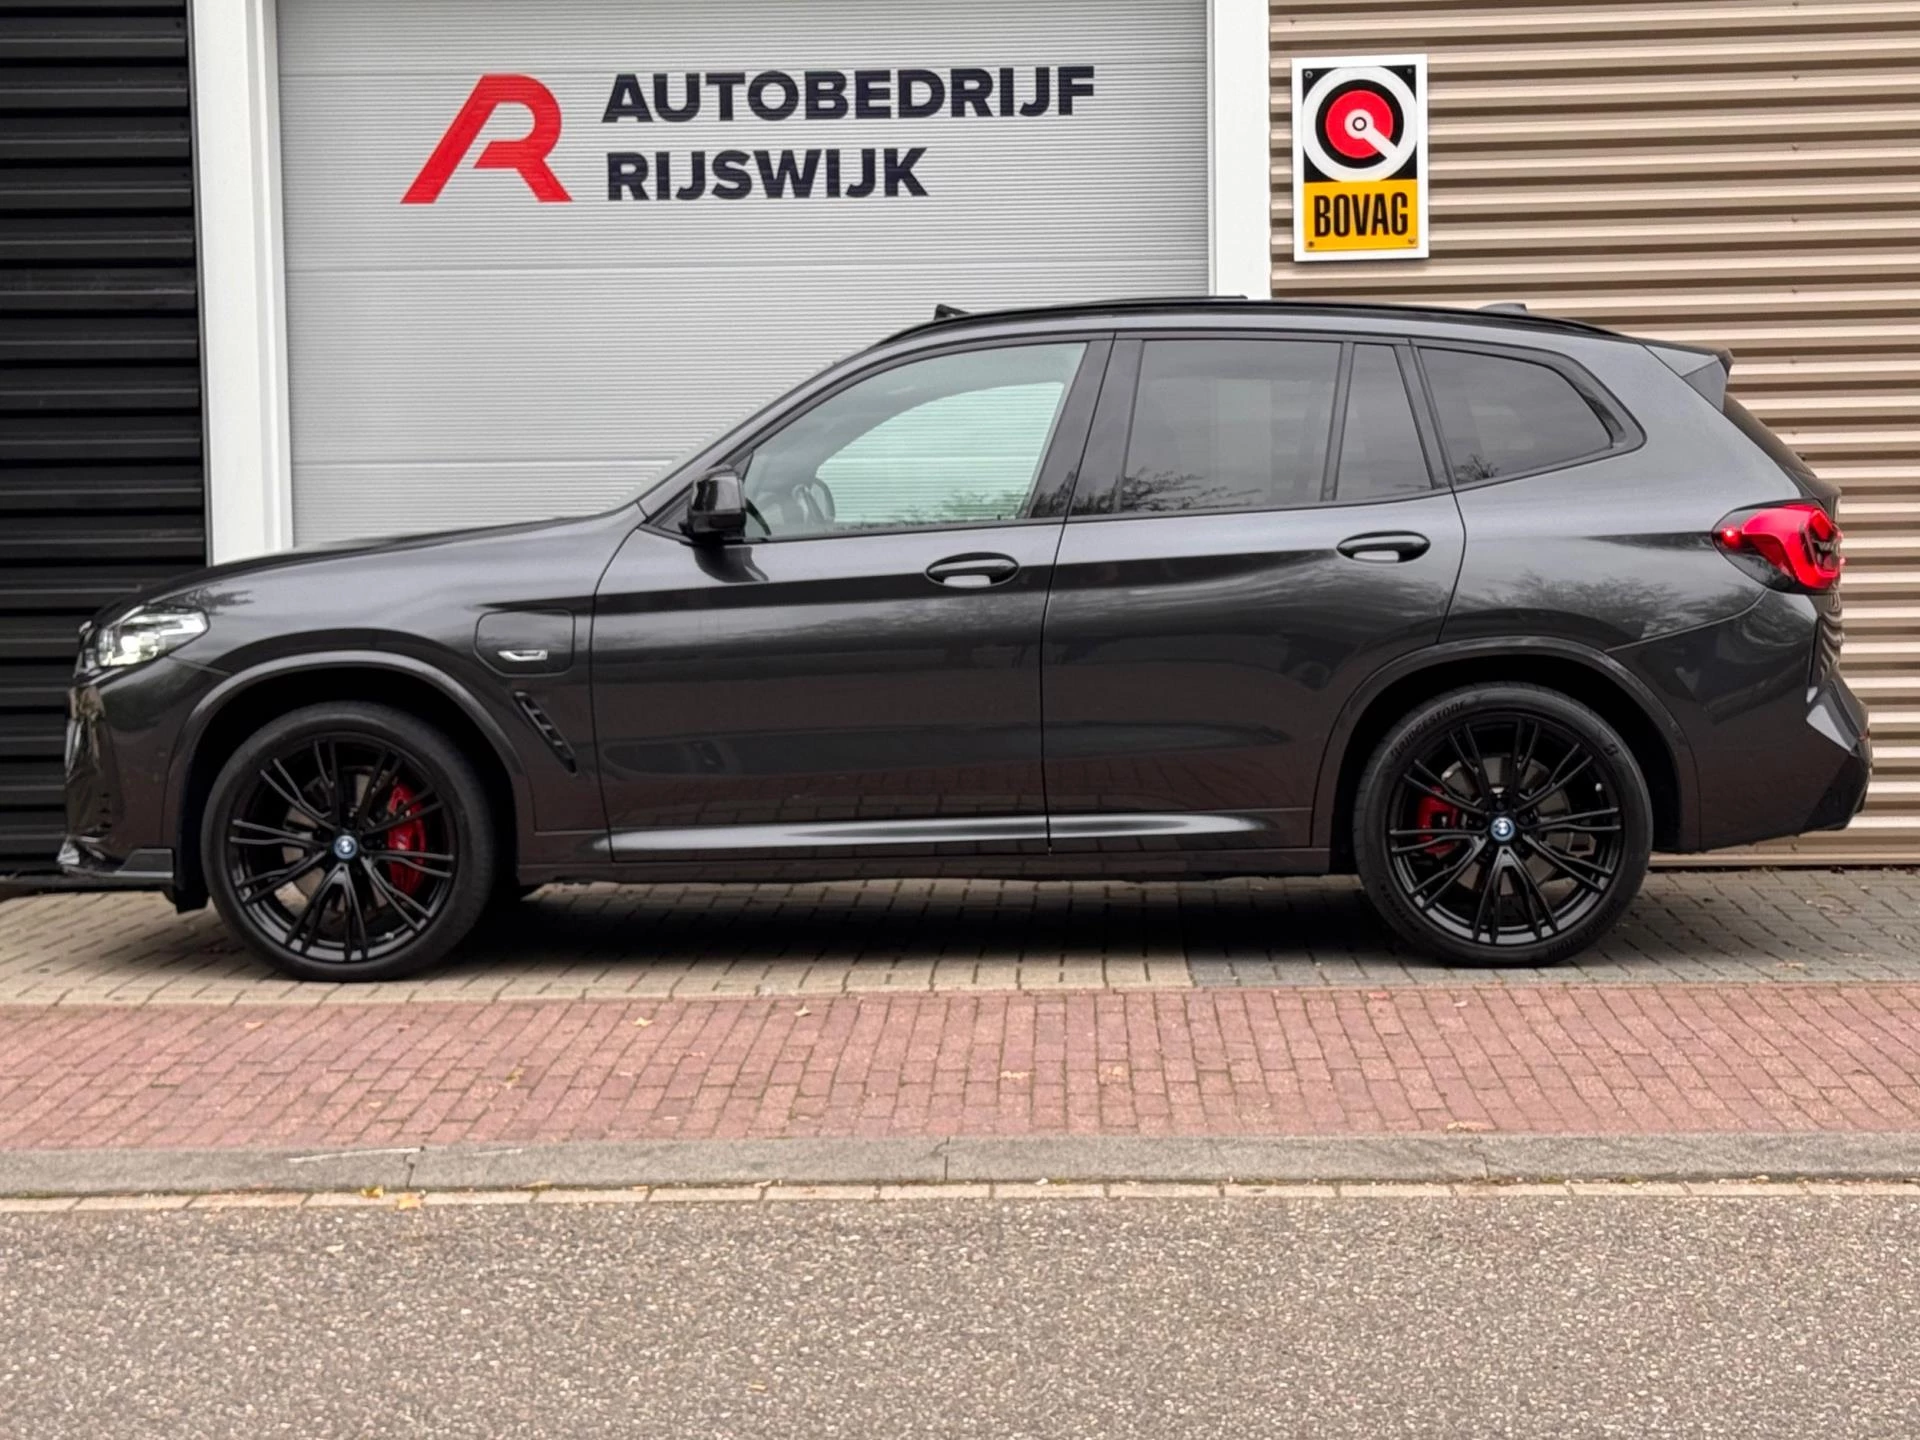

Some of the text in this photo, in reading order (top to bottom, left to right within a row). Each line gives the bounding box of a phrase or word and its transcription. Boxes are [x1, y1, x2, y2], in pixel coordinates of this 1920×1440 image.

[602, 65, 1095, 123] AUTOBEDRIJF
[607, 147, 929, 201] RIJSWIJK
[1313, 191, 1409, 238] BOVAG
